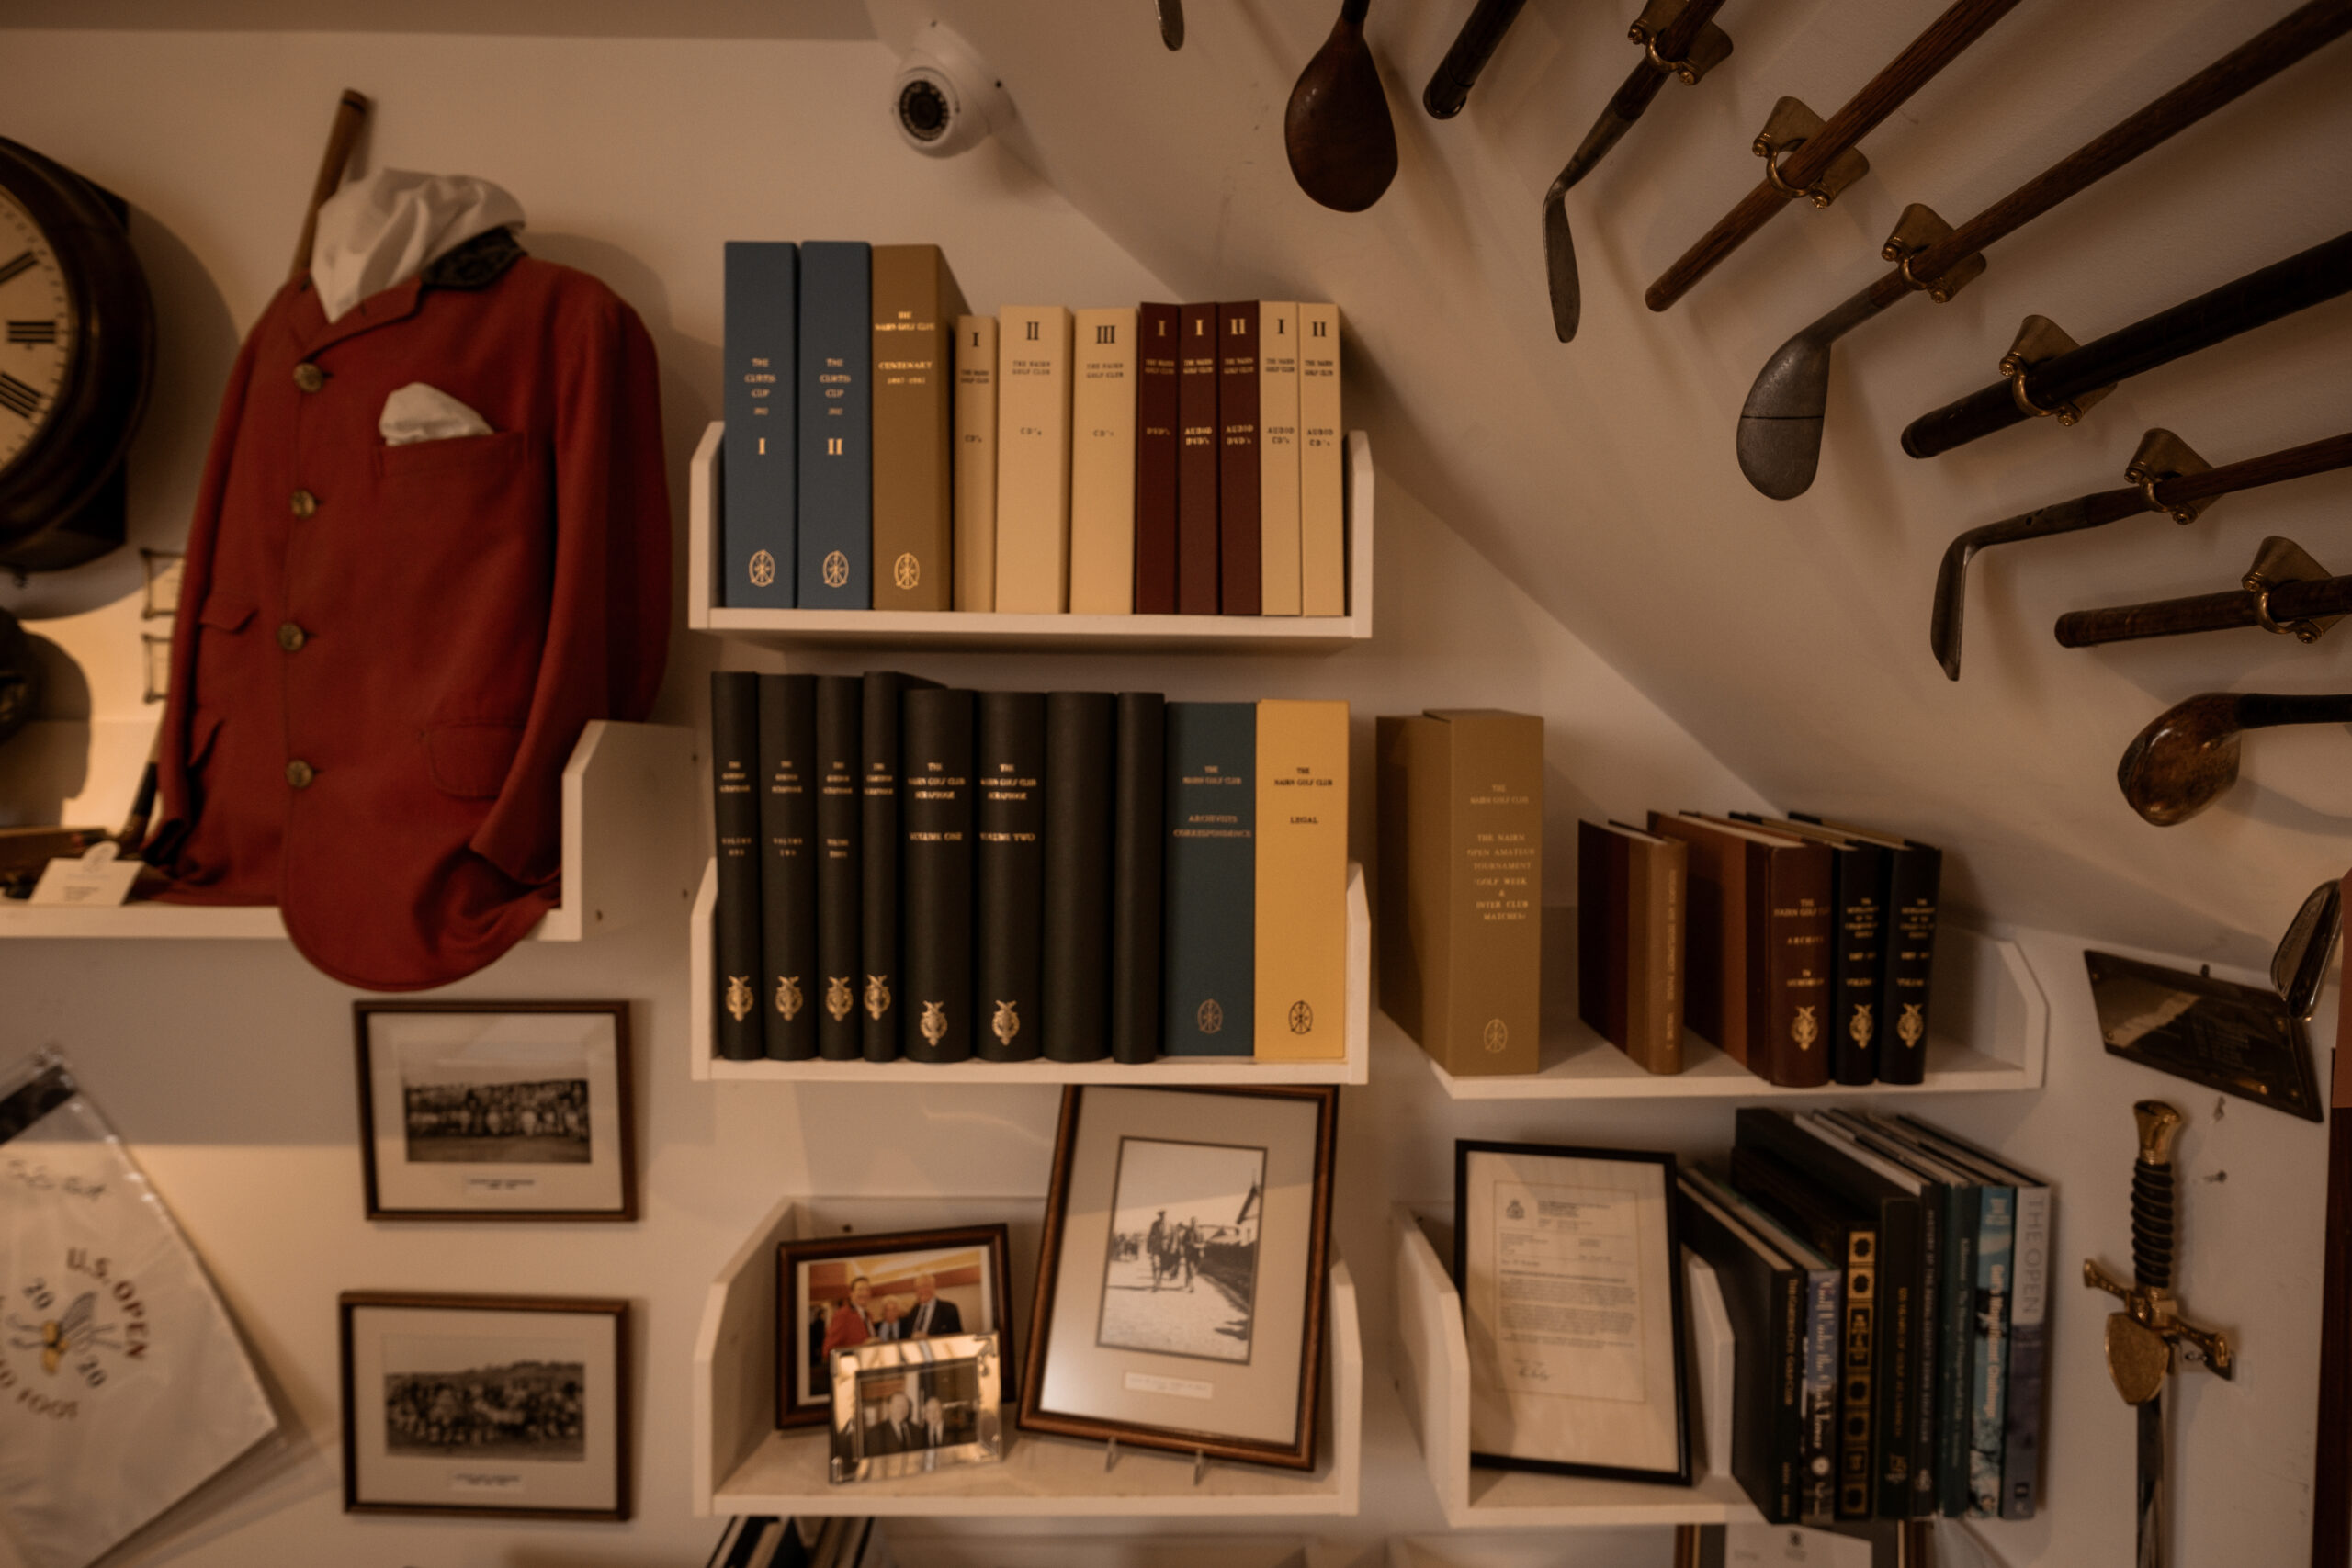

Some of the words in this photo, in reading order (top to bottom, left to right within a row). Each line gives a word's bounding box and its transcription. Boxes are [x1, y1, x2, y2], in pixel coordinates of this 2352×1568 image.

[1026, 321, 1039, 340] II
[1095, 325, 1115, 344] III
[1158, 321, 1166, 336] I
[1195, 319, 1204, 336] I
[1230, 319, 1246, 335] II
[1277, 319, 1284, 334] I
[1312, 321, 1326, 337] II
[972, 332, 979, 347] I
[878, 361, 933, 370] CENTENARY
[758, 437, 766, 456] I
[828, 437, 843, 456] II
[1012, 832, 1036, 842] TWO
[1477, 834, 1494, 842] THE
[1498, 833, 1525, 841] NAIRN
[1494, 848, 1535, 856] AMATEUR
[1473, 862, 1532, 870] TOURNAMENT
[1506, 900, 1529, 908] CLUB
[2026, 1201, 2045, 1241] THE
[2022, 1247, 2042, 1314] OPEN
[112, 1280, 147, 1362] OPEN
